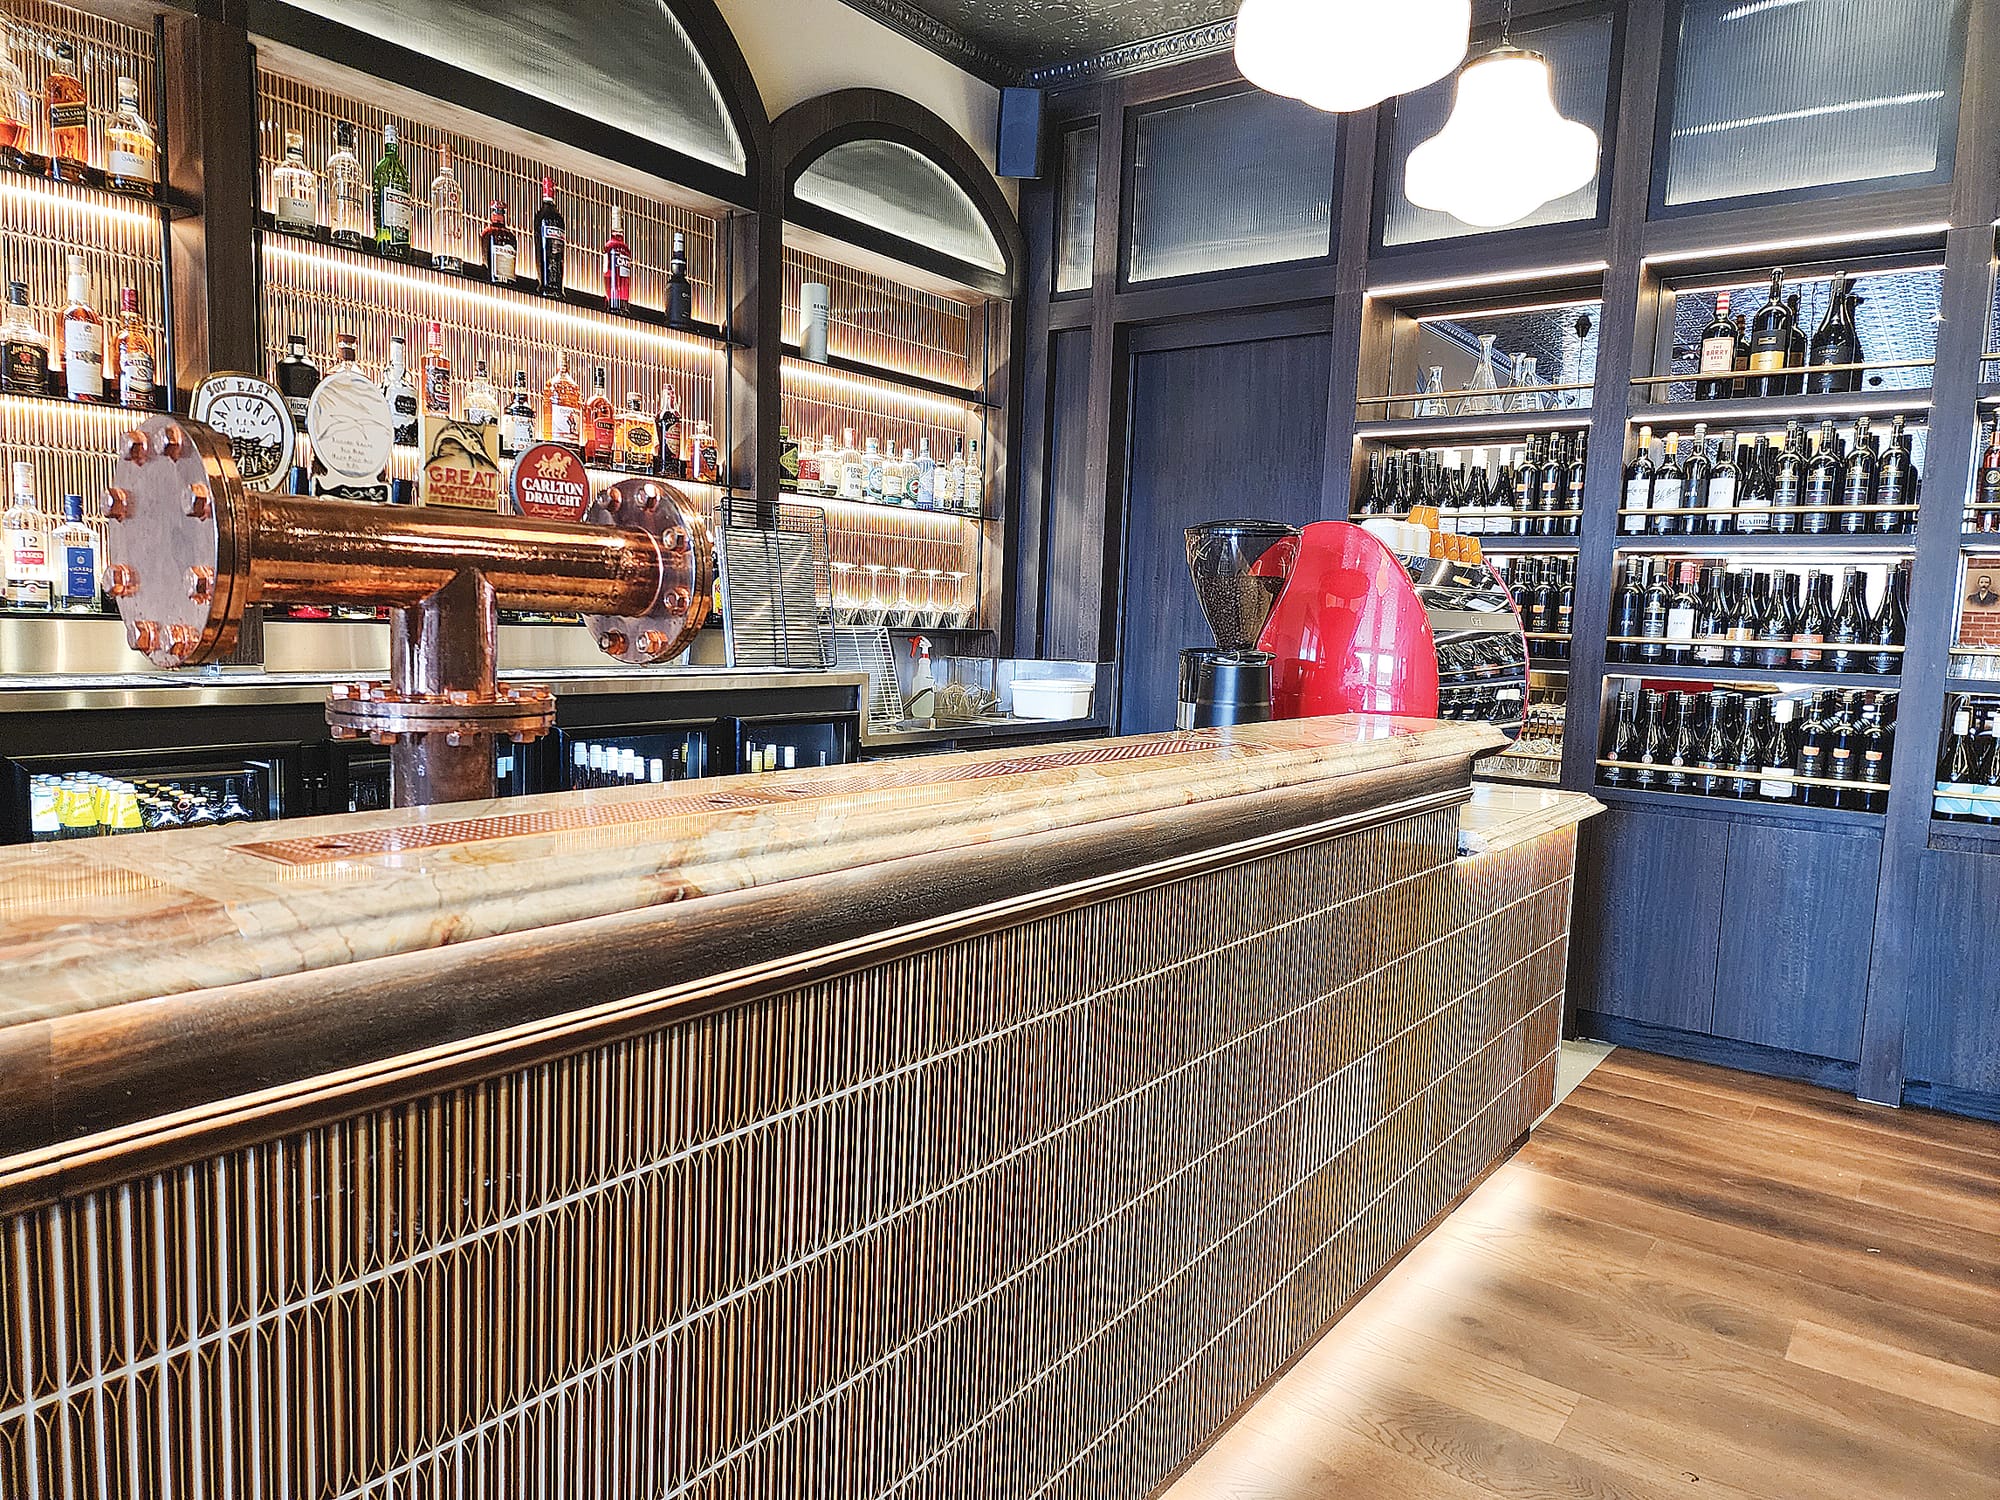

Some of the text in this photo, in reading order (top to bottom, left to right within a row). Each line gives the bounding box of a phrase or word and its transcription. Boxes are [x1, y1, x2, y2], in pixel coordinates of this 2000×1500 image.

[1706, 349, 1729, 357] BARRY
[236, 381, 274, 397] EAST
[212, 398, 276, 428] SAILORS
[429, 465, 496, 488] GREAT
[429, 483, 496, 499] NORTHERN
[521, 477, 584, 496] CARLTON
[525, 490, 583, 508] DRAUGHT
[21, 535, 38, 548] 12
